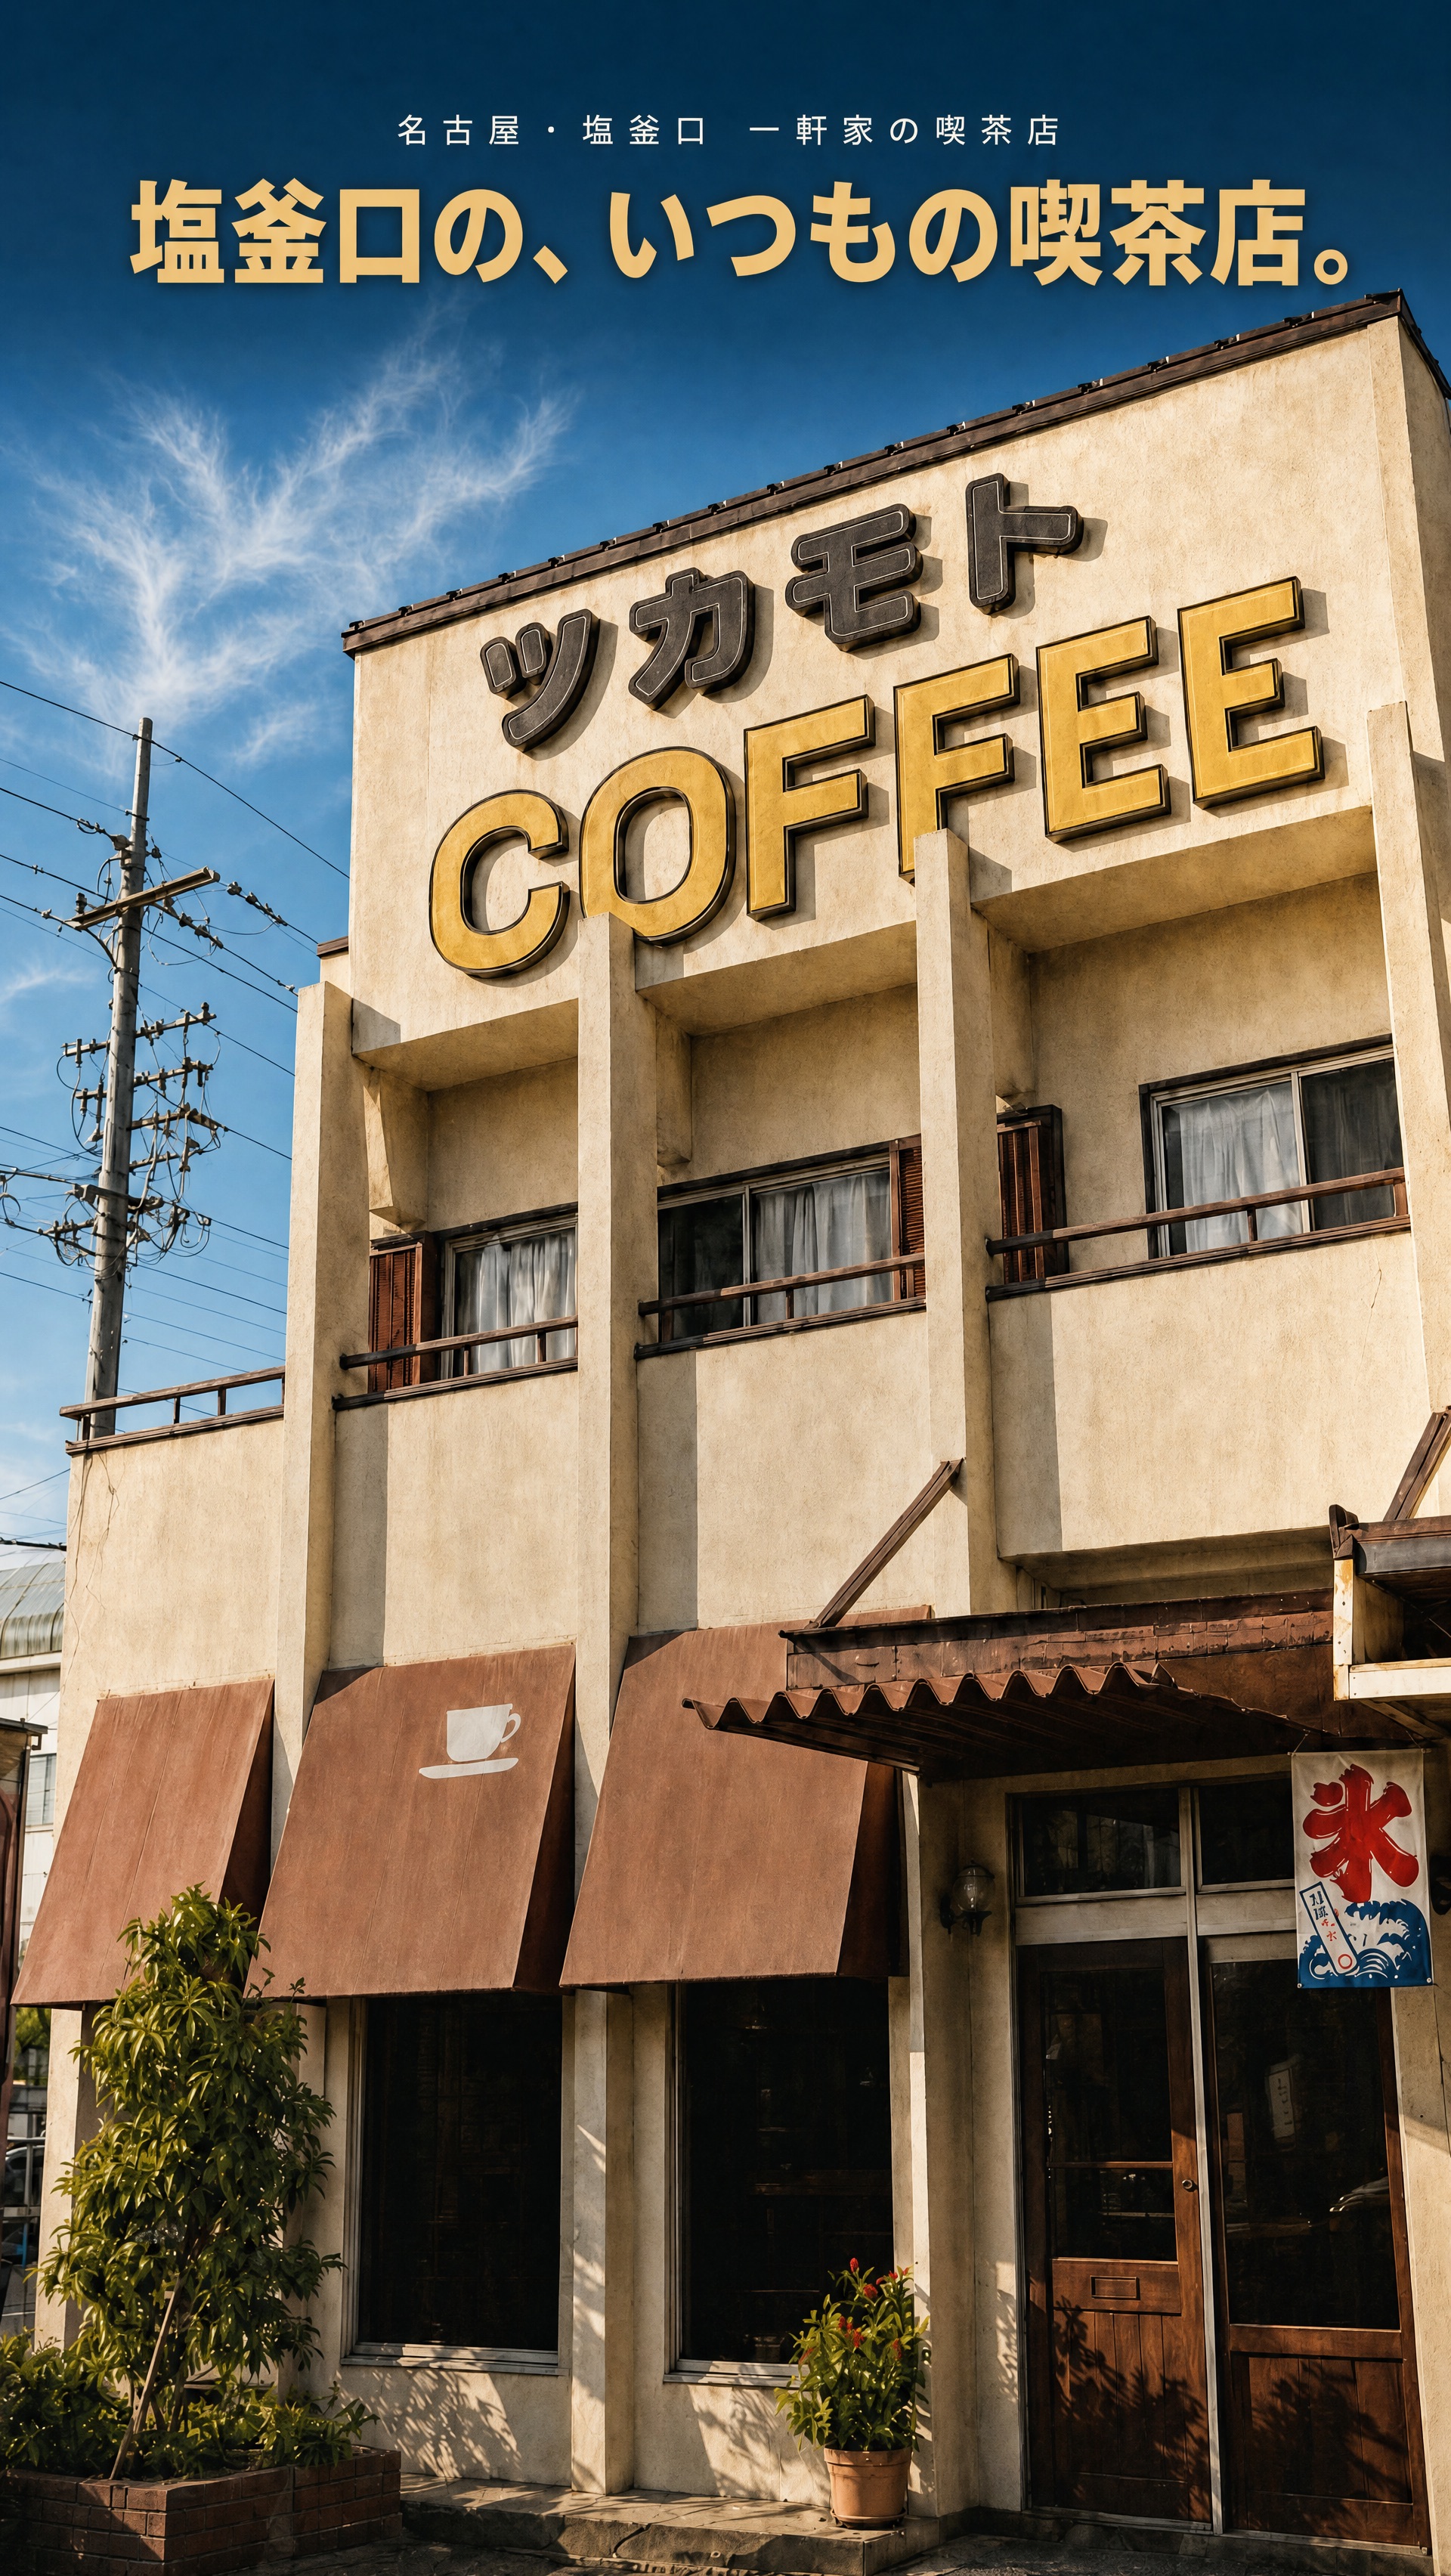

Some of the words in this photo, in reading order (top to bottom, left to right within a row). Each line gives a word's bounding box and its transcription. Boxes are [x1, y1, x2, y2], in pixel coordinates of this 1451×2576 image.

[481, 472, 1084, 752] ツカモト
[428, 576, 1326, 978] COFFEE
[1303, 1763, 1419, 1904] 氷
